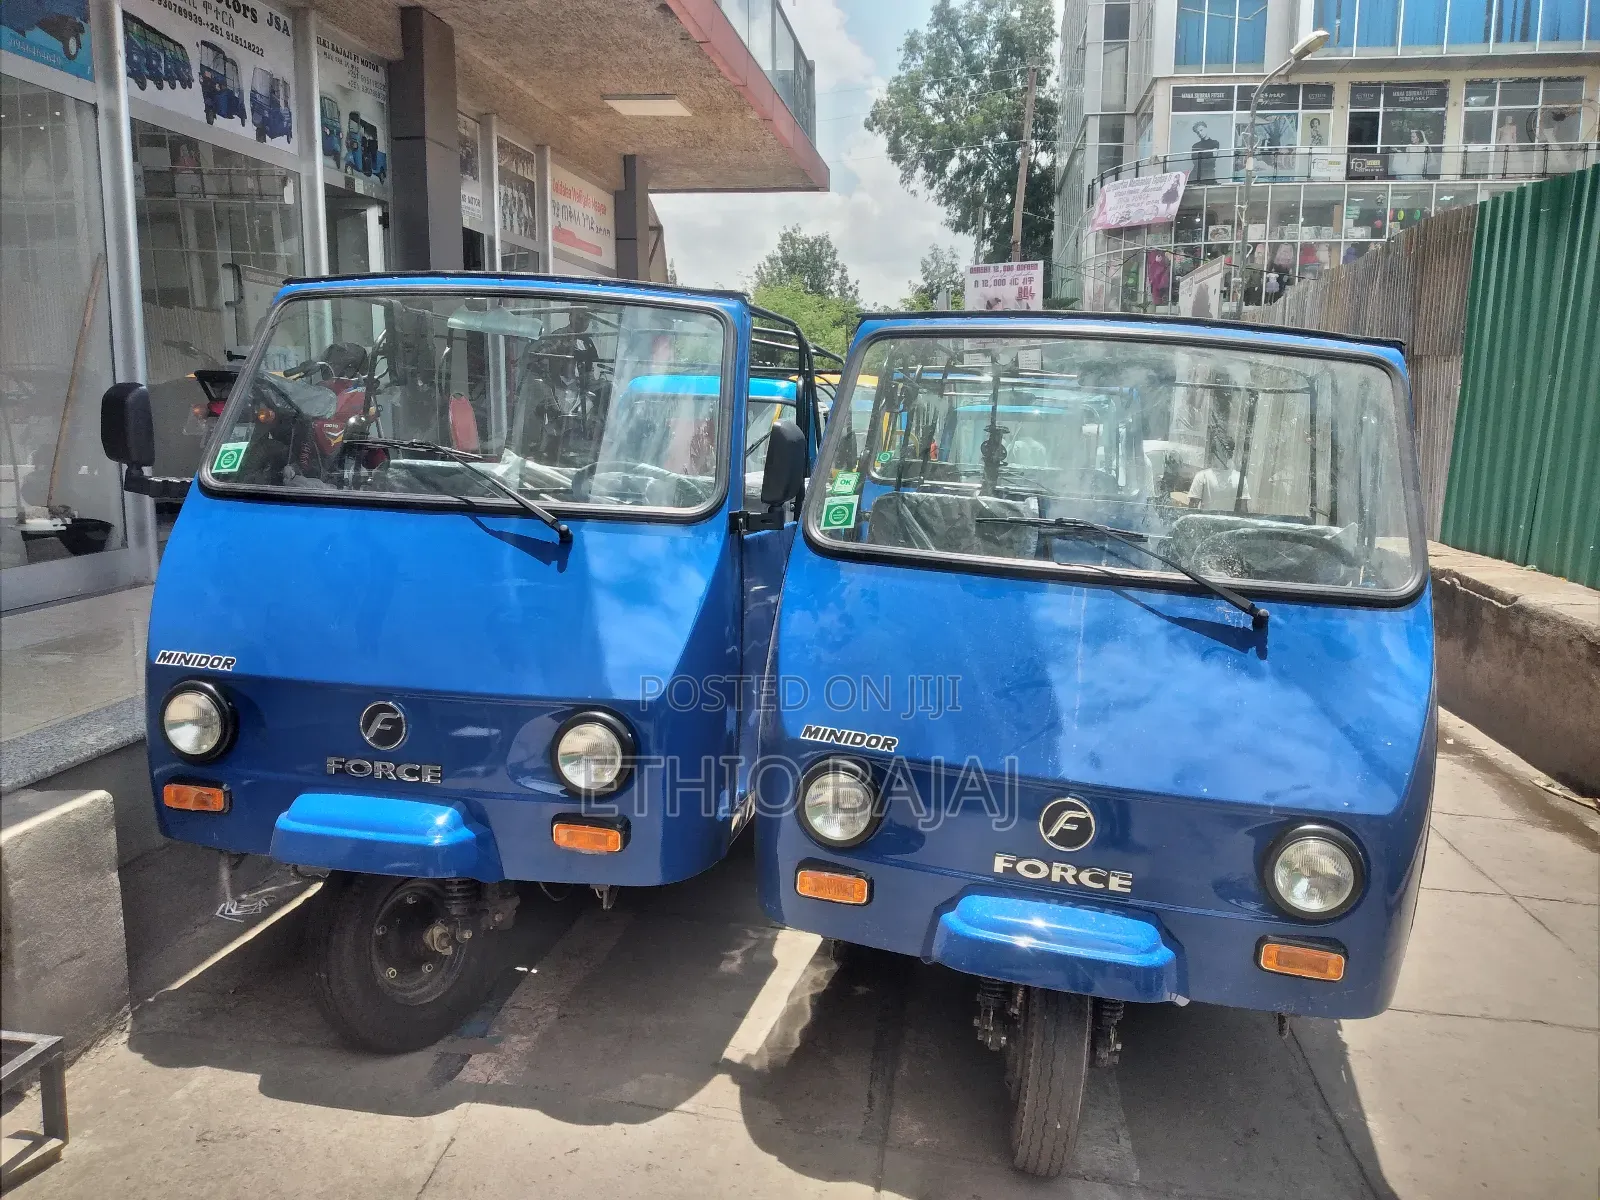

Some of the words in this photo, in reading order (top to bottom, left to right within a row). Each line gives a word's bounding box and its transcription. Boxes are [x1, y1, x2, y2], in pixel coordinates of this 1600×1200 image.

[266, 11, 291, 37] JSA
[225, 30, 265, 57] 915118222
[982, 279, 1006, 288] 12,000
[155, 650, 237, 671] MINIDOR
[800, 724, 898, 752] MINIDOR
[326, 756, 442, 785] FORCE
[993, 852, 1133, 893] FORCE
